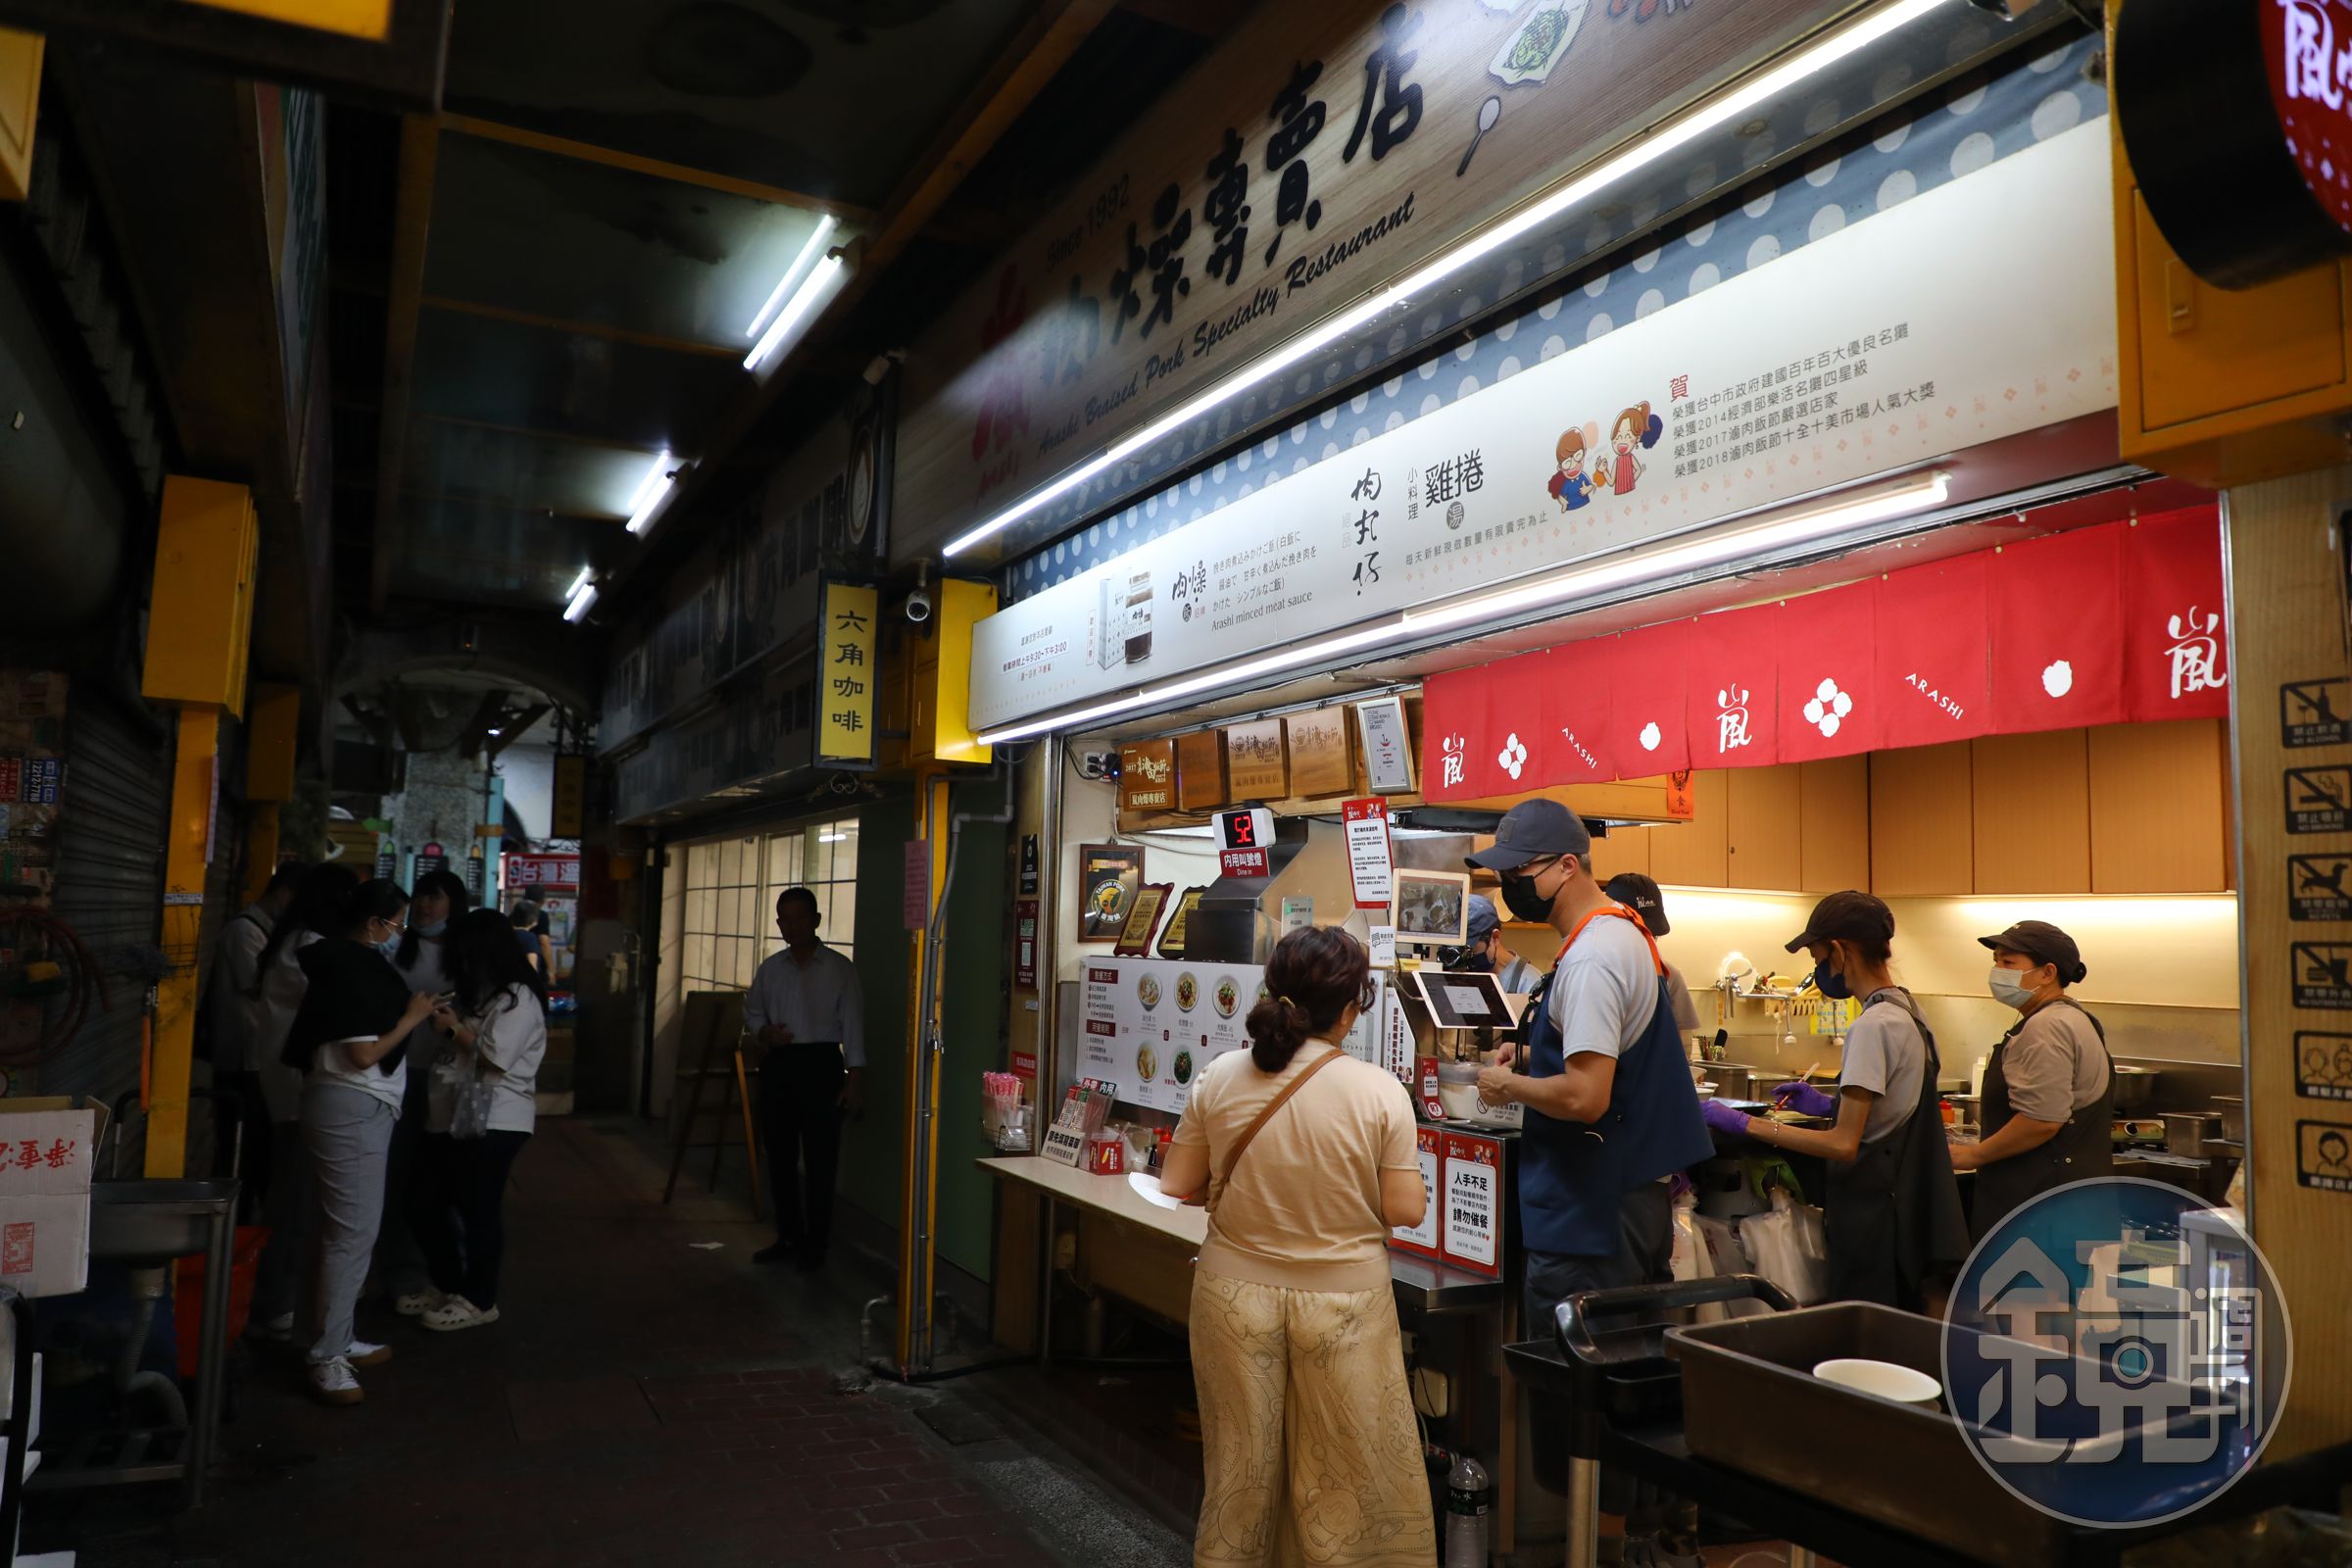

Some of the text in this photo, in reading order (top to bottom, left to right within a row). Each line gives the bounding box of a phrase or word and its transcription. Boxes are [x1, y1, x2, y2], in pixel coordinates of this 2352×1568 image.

[1046, 172, 1131, 274] Since 1992
[1084, 373, 1138, 427] Braised
[1146, 340, 1185, 395] Pork
[1193, 283, 1280, 360] Specialty
[1285, 191, 1416, 299] Restaurant
[1670, 374, 1689, 402] 賀
[1407, 468, 1418, 520] 小料理
[1425, 448, 1484, 509] 雞捲
[1447, 503, 1464, 529] 湯
[1211, 591, 1313, 632] Arashi minced meat sauce
[832, 610, 867, 732] 六角咖啡
[2164, 606, 2228, 699] 嵐
[1904, 671, 1964, 720] ARASHI
[1716, 683, 1753, 754] 嵐
[1442, 731, 1466, 789] 嵐
[1561, 726, 1598, 769] ARASHI
[1235, 815, 1251, 843] 52
[1224, 853, 1262, 867] 內用叫號燈
[1096, 882, 1125, 895] TAIWAN PORK
[1099, 1082, 1114, 1095] 內用
[0, 1138, 75, 1171] 淨重:
[1454, 1172, 1488, 1192] 人手不足
[1452, 1207, 1488, 1229] 請勿催餐
